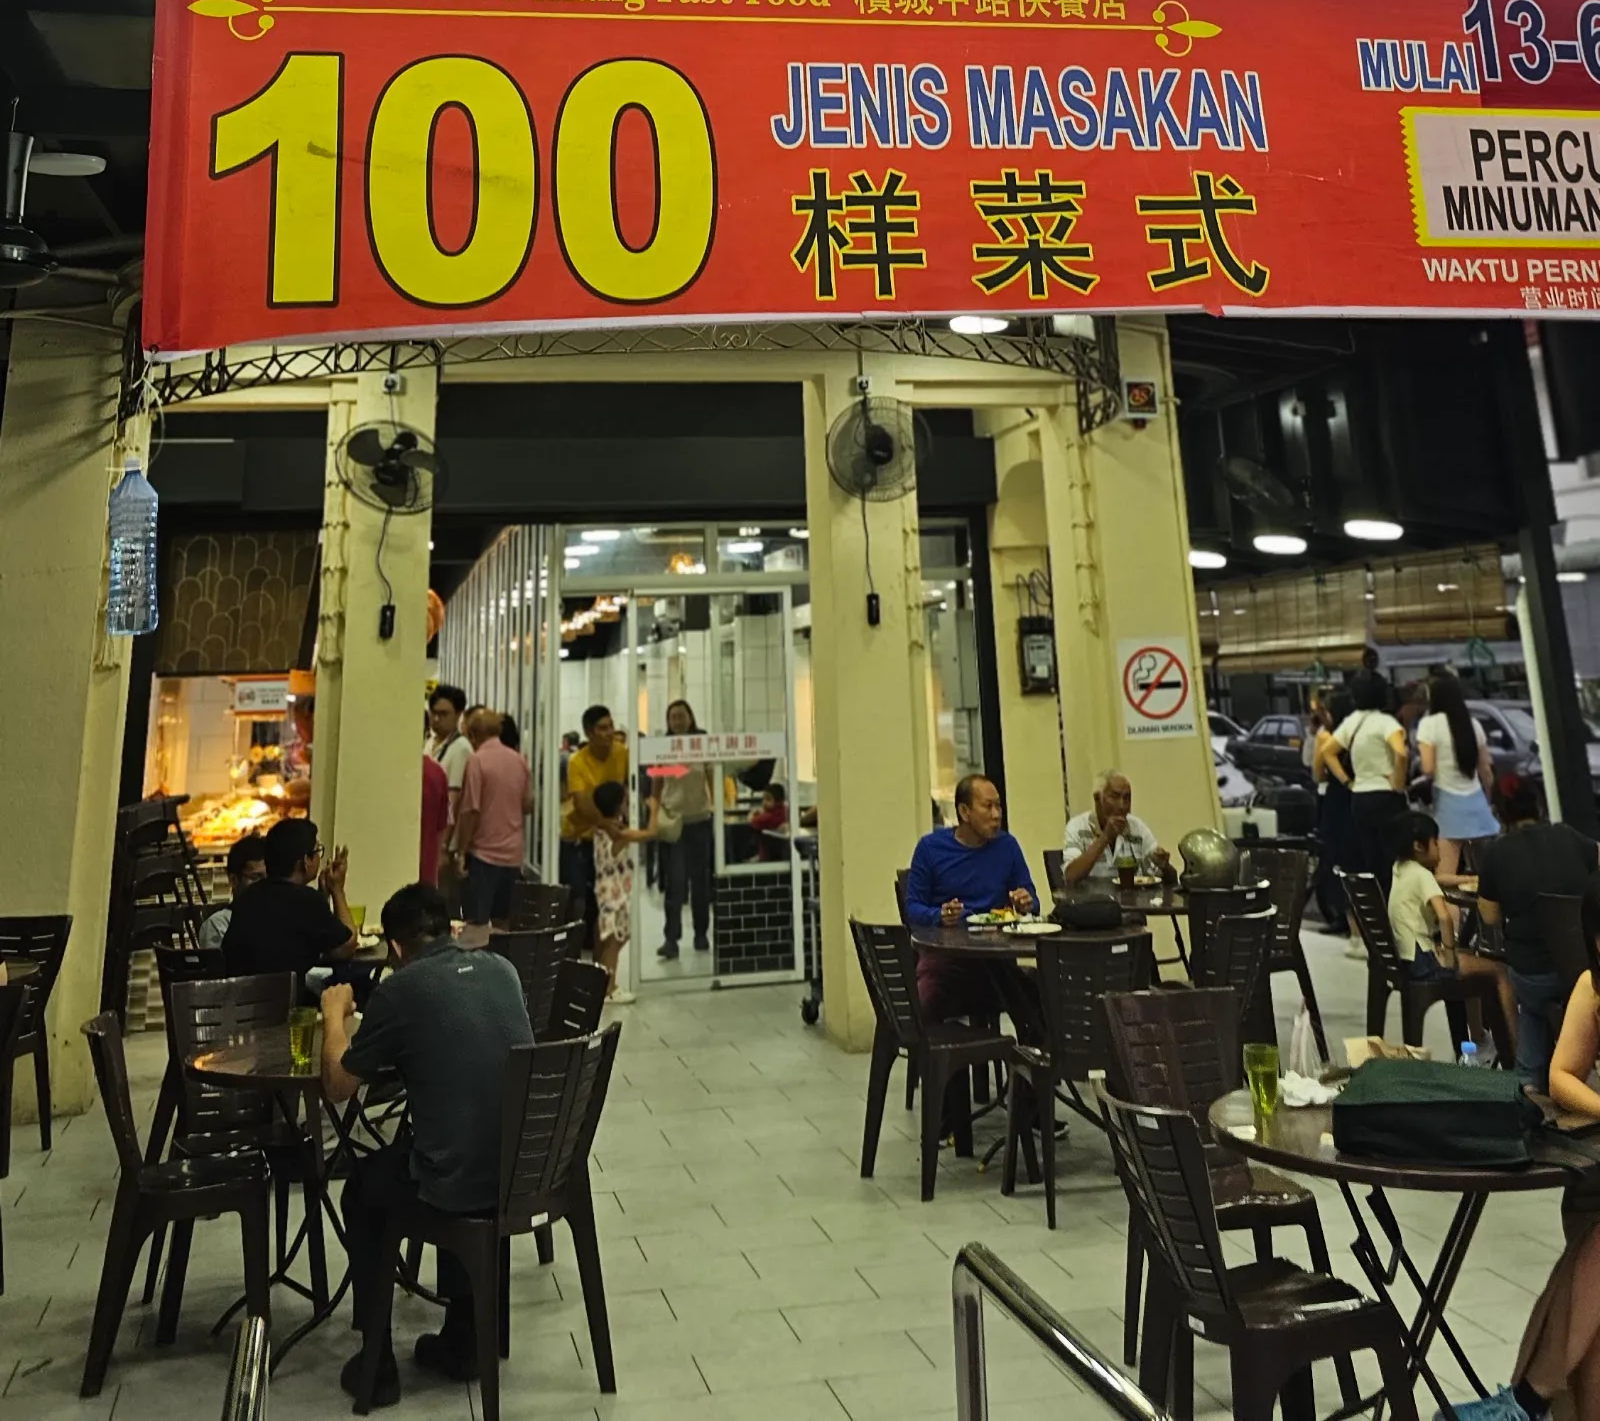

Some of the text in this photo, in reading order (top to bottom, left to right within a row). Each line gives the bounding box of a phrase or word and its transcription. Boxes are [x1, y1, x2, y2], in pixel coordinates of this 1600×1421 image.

[1356, 37, 1481, 95] MULAI
[770, 62, 1269, 153] JENIS MASAKAN
[208, 51, 717, 310] 100
[1442, 185, 1600, 232] MINUMAN
[790, 167, 1270, 301] 样菜式
[1422, 258, 1600, 283] WAKTU PERN
